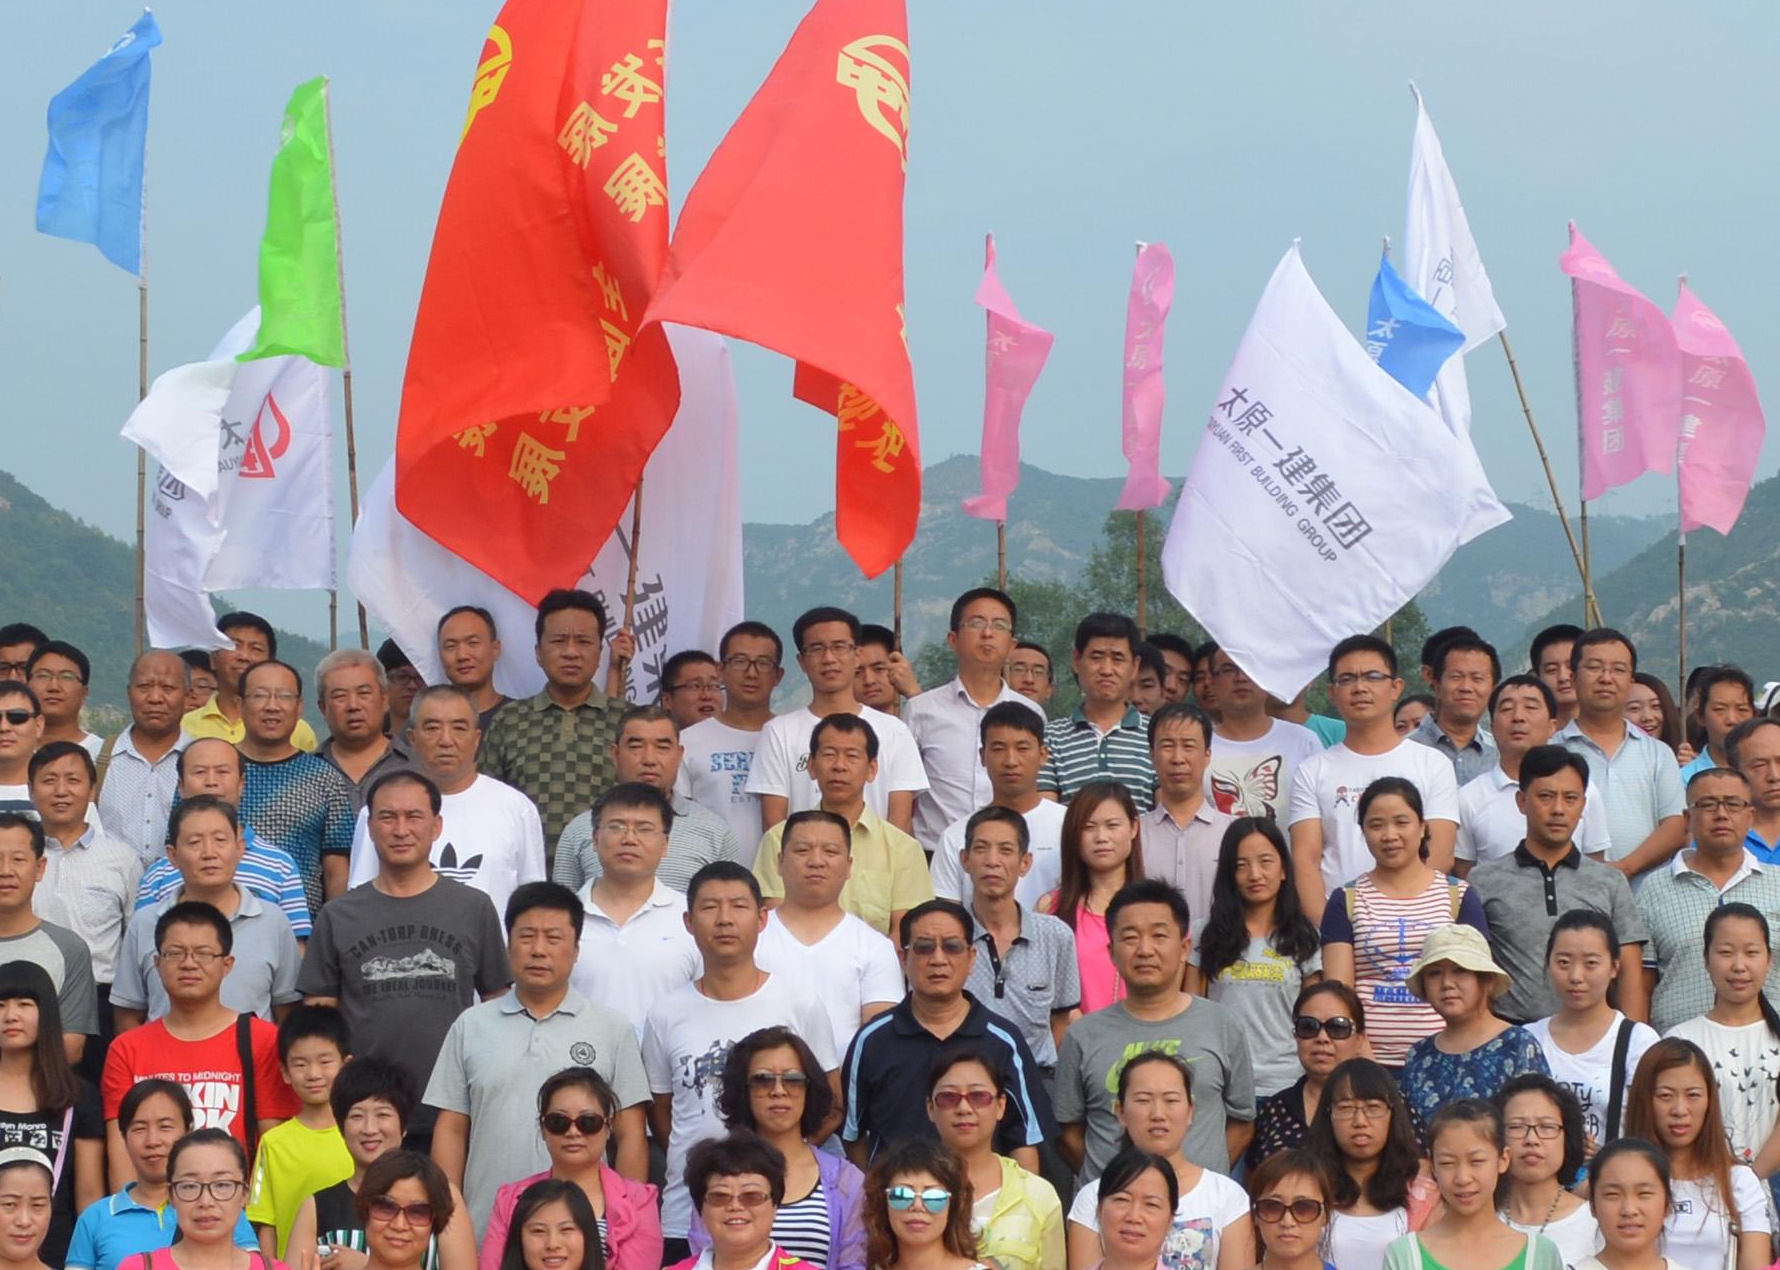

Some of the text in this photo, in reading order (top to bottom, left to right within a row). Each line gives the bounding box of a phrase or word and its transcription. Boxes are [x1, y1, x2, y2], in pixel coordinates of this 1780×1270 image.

[1219, 387, 1372, 549] 太原一建集团
[1252, 463, 1298, 520] BUILDING
[1298, 517, 1338, 564] GROUP
[178, 1073, 191, 1082] TO
[193, 1072, 241, 1082] MIDNIGHT
